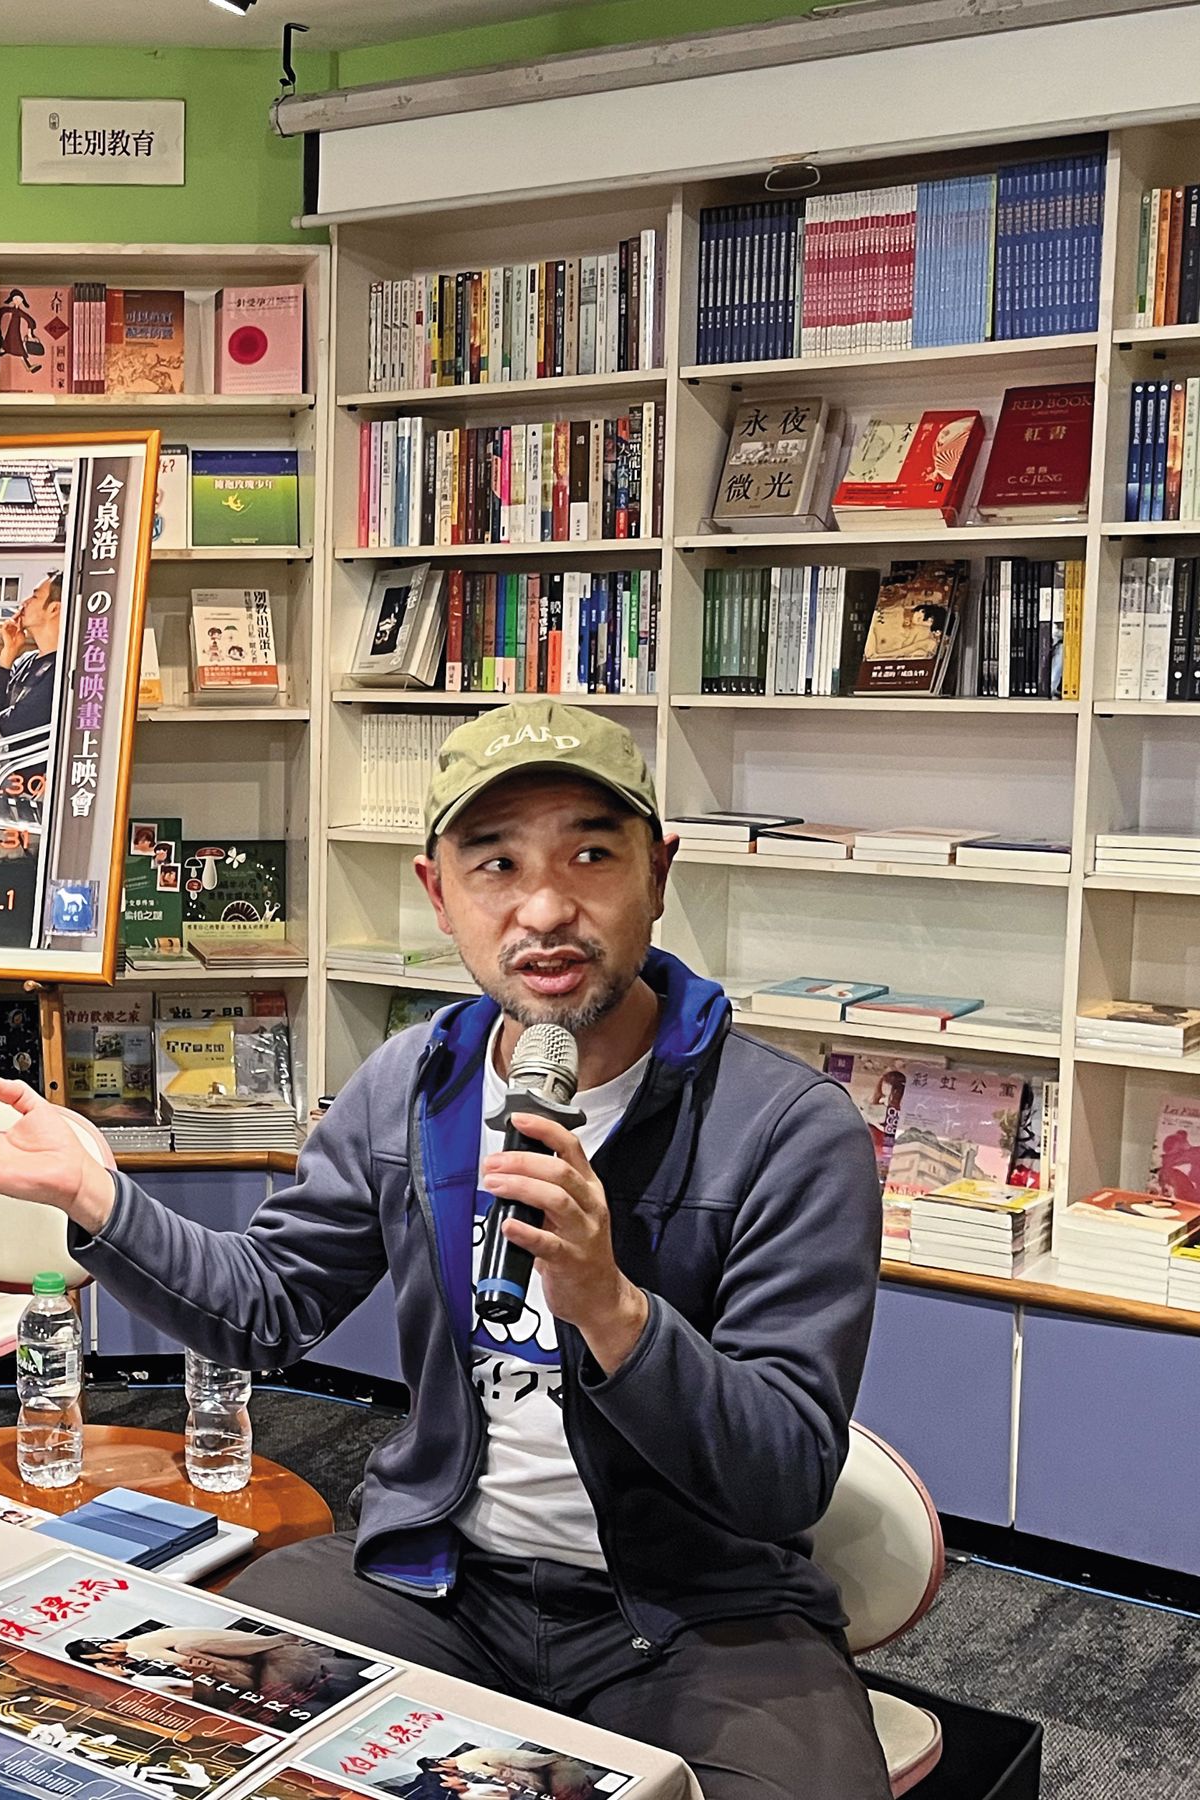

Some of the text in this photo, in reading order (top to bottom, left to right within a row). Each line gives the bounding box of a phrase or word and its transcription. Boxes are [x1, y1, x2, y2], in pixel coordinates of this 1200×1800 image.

[59, 129, 155, 157] 性別教育
[1011, 395, 1093, 411] RED BOOK
[740, 405, 809, 437] 永夜
[1023, 424, 1068, 442] 紅書
[725, 471, 795, 504] 微光
[69, 473, 125, 818] 今泉浩一の異色映畫上映會
